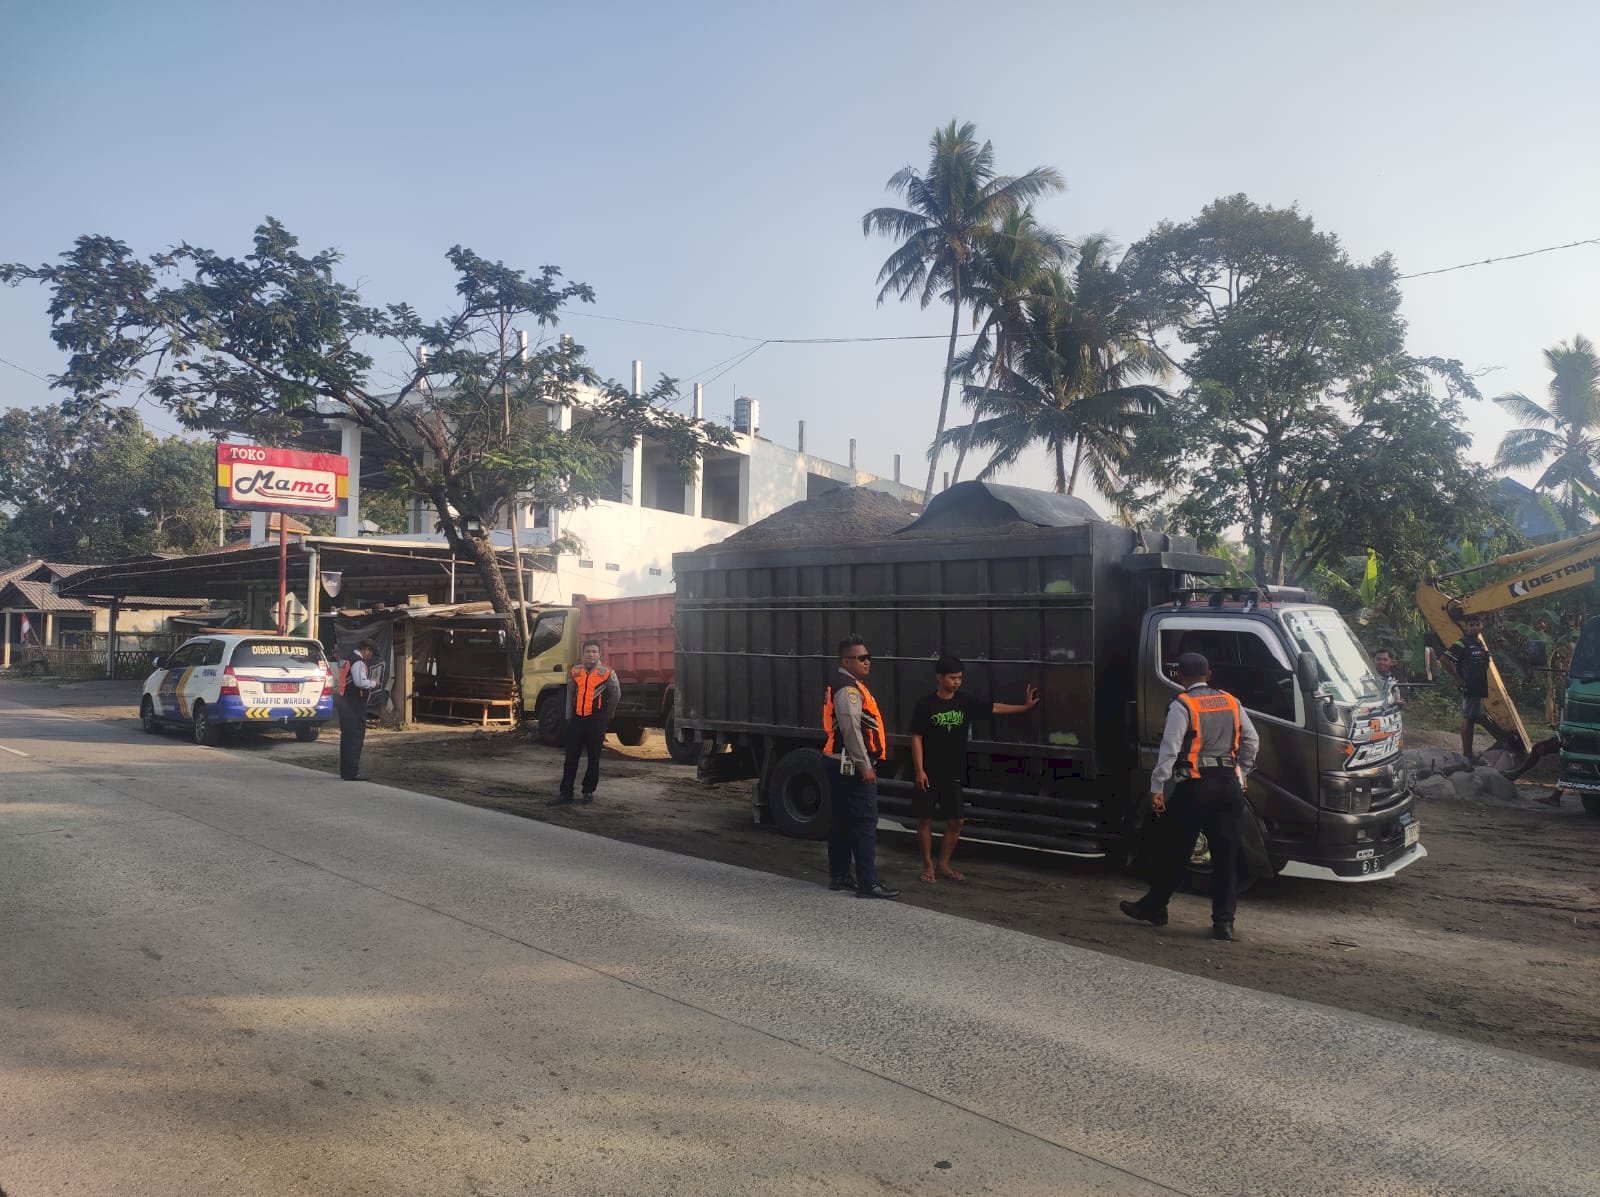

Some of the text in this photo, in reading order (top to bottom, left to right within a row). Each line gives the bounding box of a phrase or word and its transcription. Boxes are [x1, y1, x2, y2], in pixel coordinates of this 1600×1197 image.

[230, 448, 266, 461] TOKO
[234, 469, 330, 496] Mama
[252, 645, 309, 657] DISHUB KLATEN
[252, 697, 311, 705] TRAFFIC WARDEN
